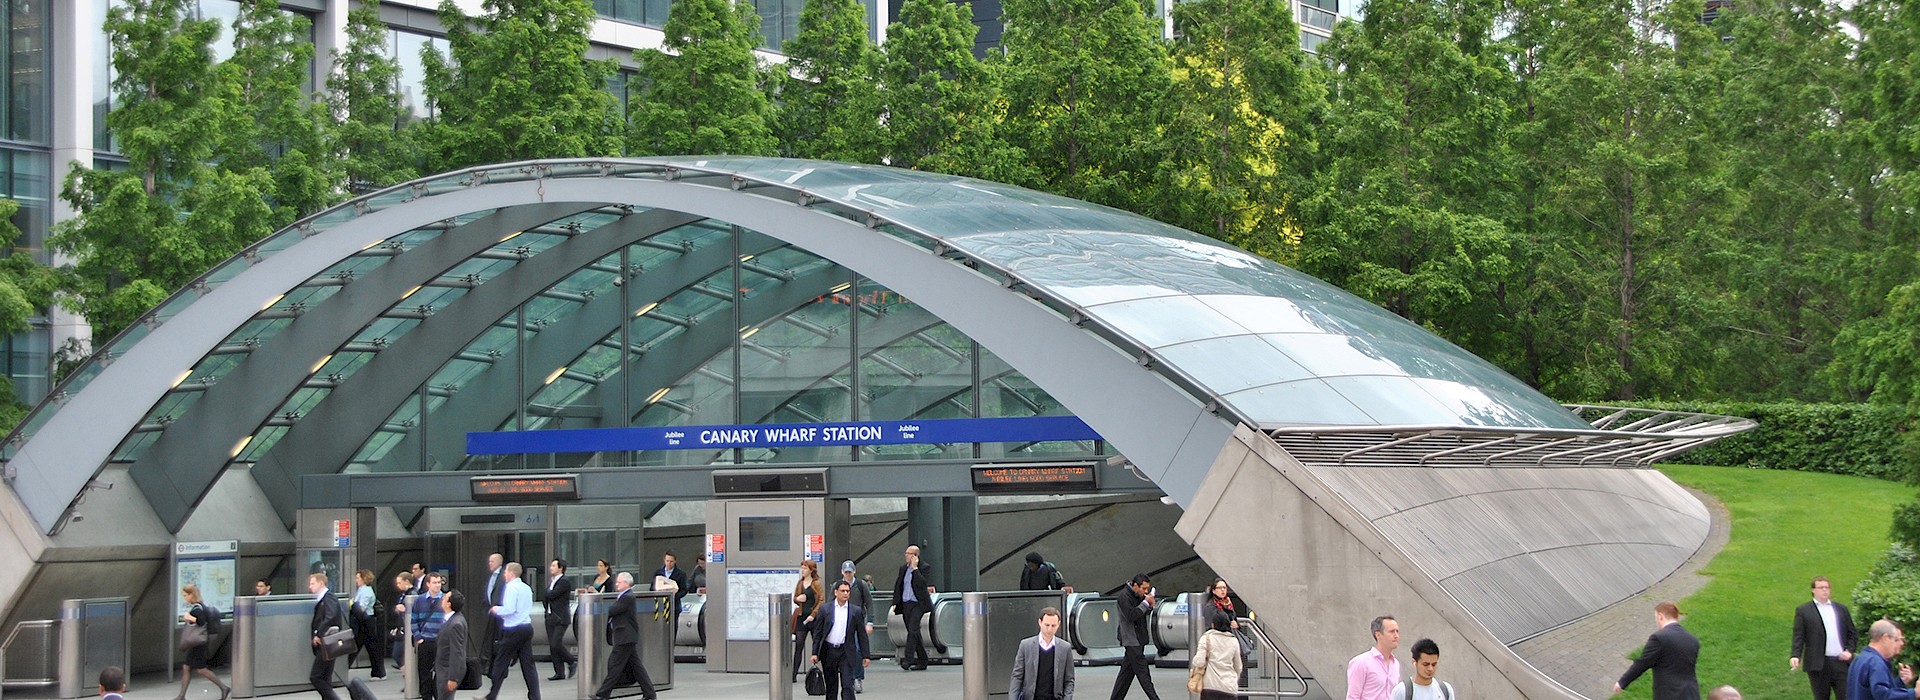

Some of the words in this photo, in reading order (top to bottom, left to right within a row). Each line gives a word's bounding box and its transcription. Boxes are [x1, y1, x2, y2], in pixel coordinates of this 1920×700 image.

[898, 424, 919, 432] Jubilee
[700, 429, 758, 444] CANARY
[764, 427, 817, 443] WHARF
[822, 426, 882, 441] STATION
